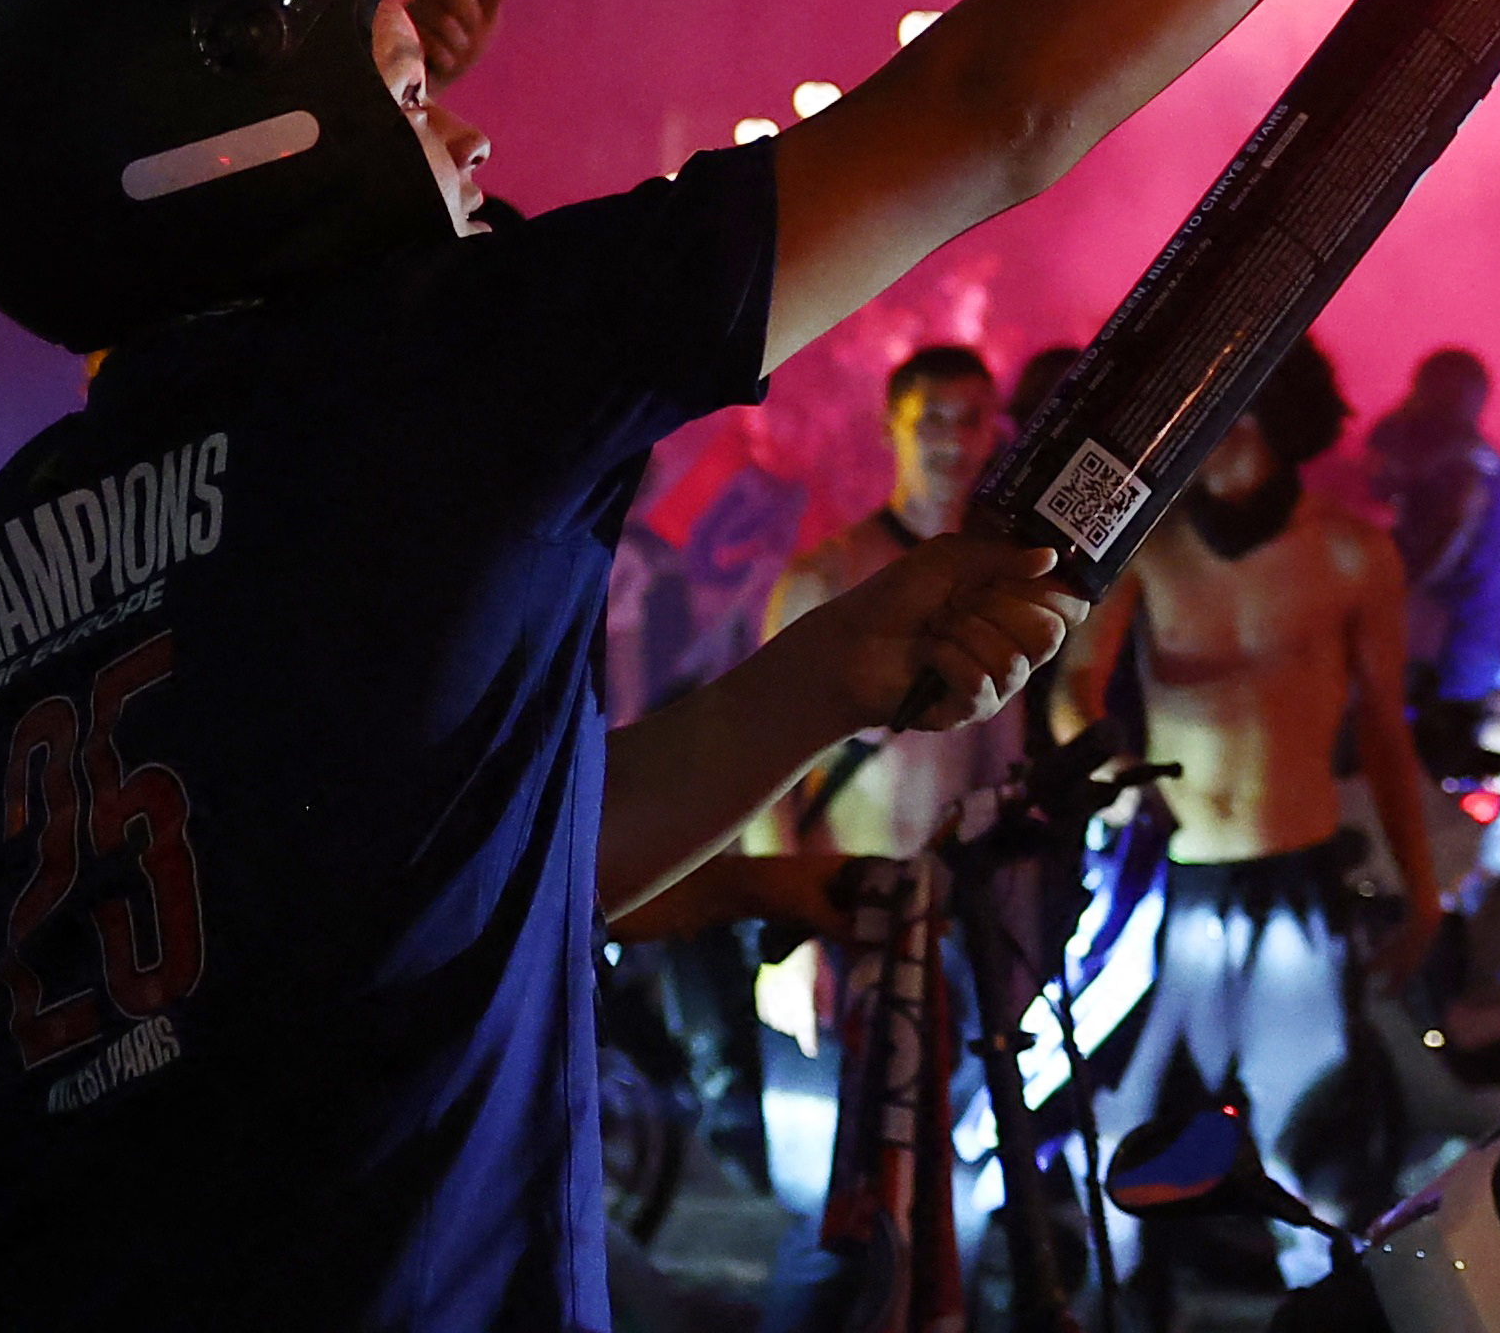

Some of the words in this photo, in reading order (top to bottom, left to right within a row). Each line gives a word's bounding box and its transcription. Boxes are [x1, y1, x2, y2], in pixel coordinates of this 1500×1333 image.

[1145, 235, 1186, 282] BLUE
[1181, 211, 1204, 236] TO
[1243, 100, 1291, 156] STARS
[30, 576, 166, 669] EUROPE
[106, 1014, 181, 1087] PARIS
